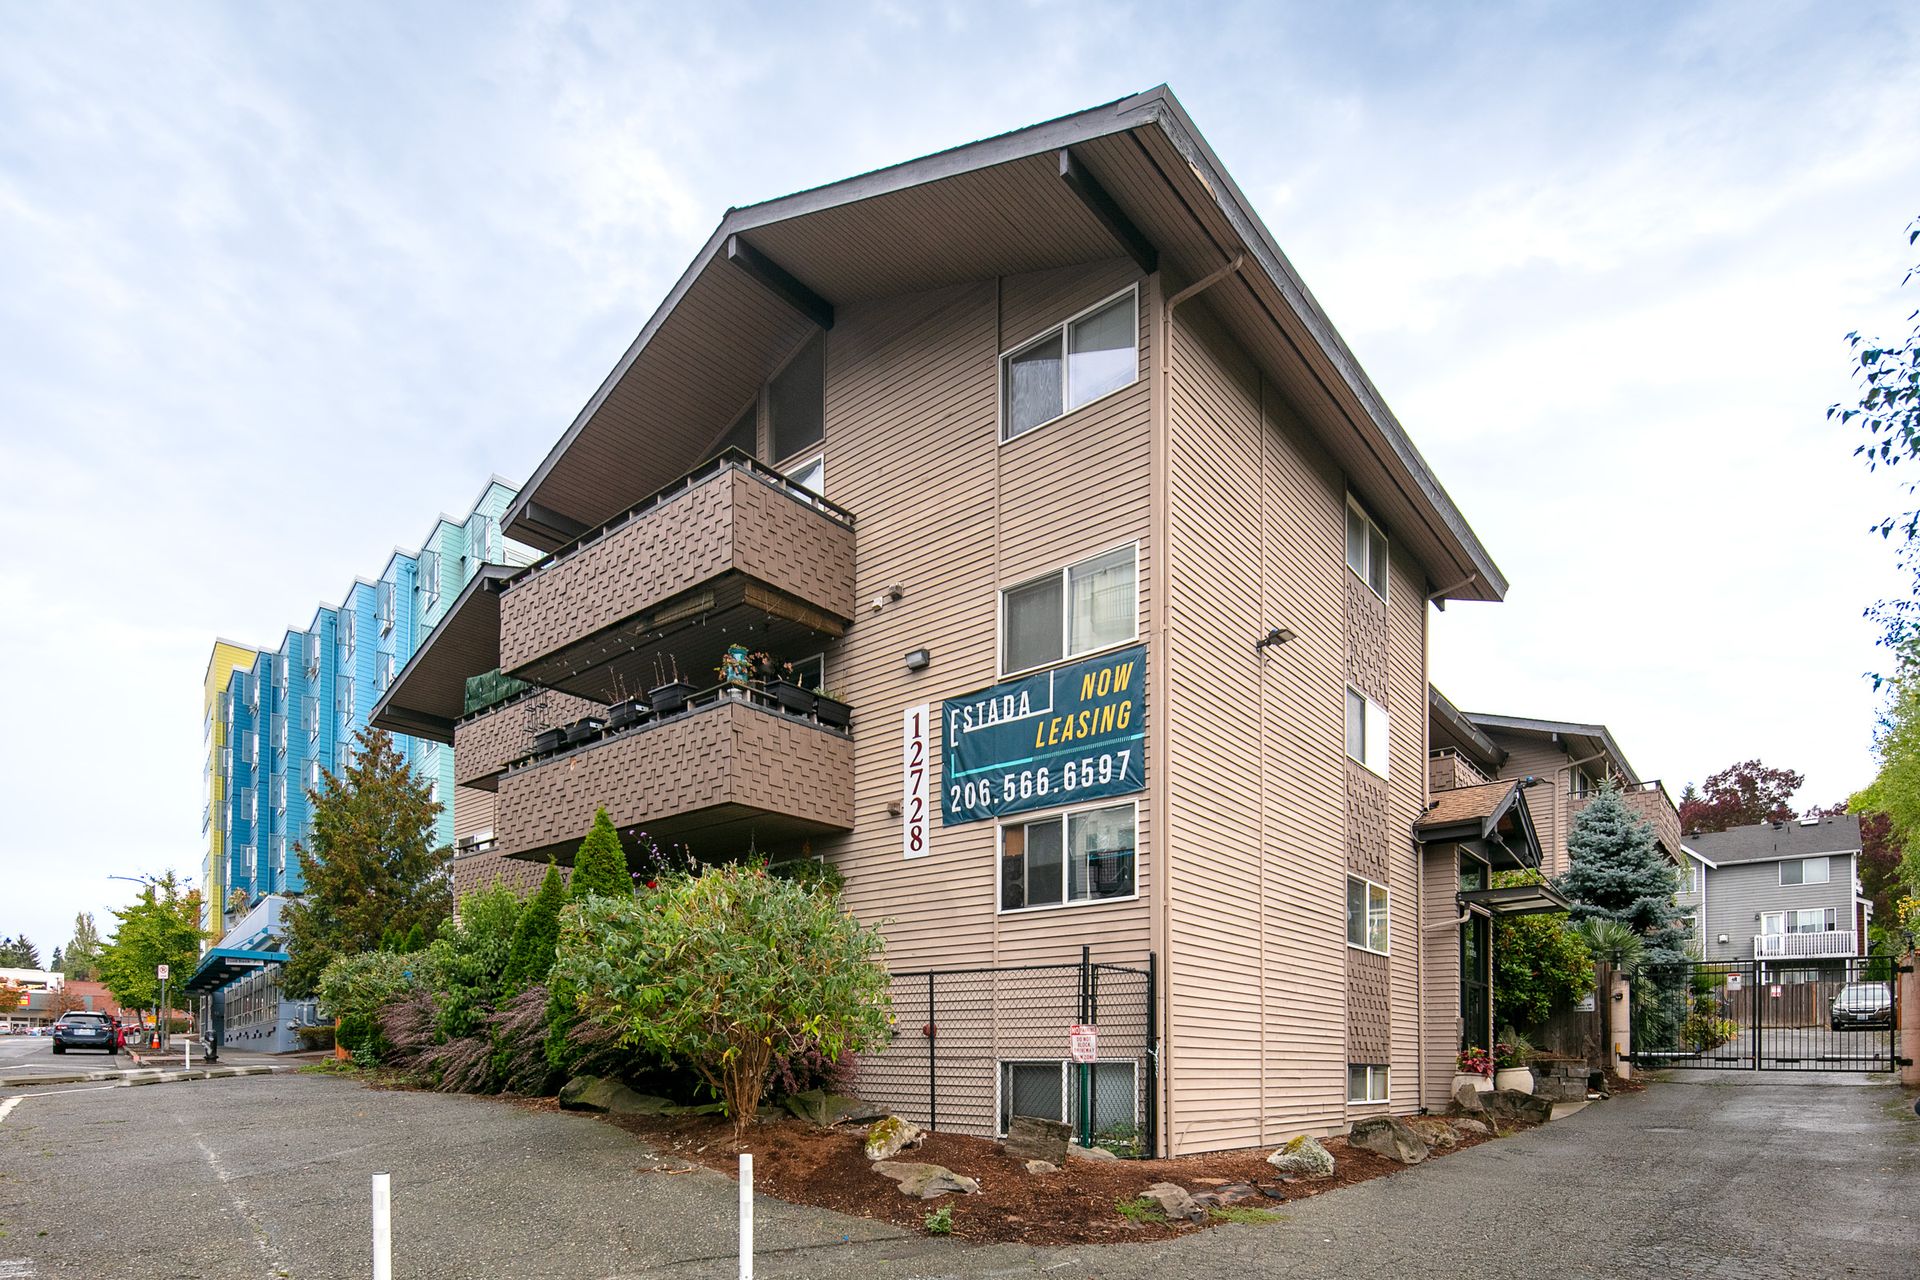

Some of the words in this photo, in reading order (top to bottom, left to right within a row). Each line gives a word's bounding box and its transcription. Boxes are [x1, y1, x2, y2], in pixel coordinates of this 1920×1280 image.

[1080, 662, 1134, 701] NOW
[950, 690, 1031, 747] ESTADA
[1035, 700, 1132, 748] LEASING
[909, 712, 924, 852] 12728
[950, 749, 1131, 813] 206.566.6597
[1072, 1026, 1079, 1034] NO
